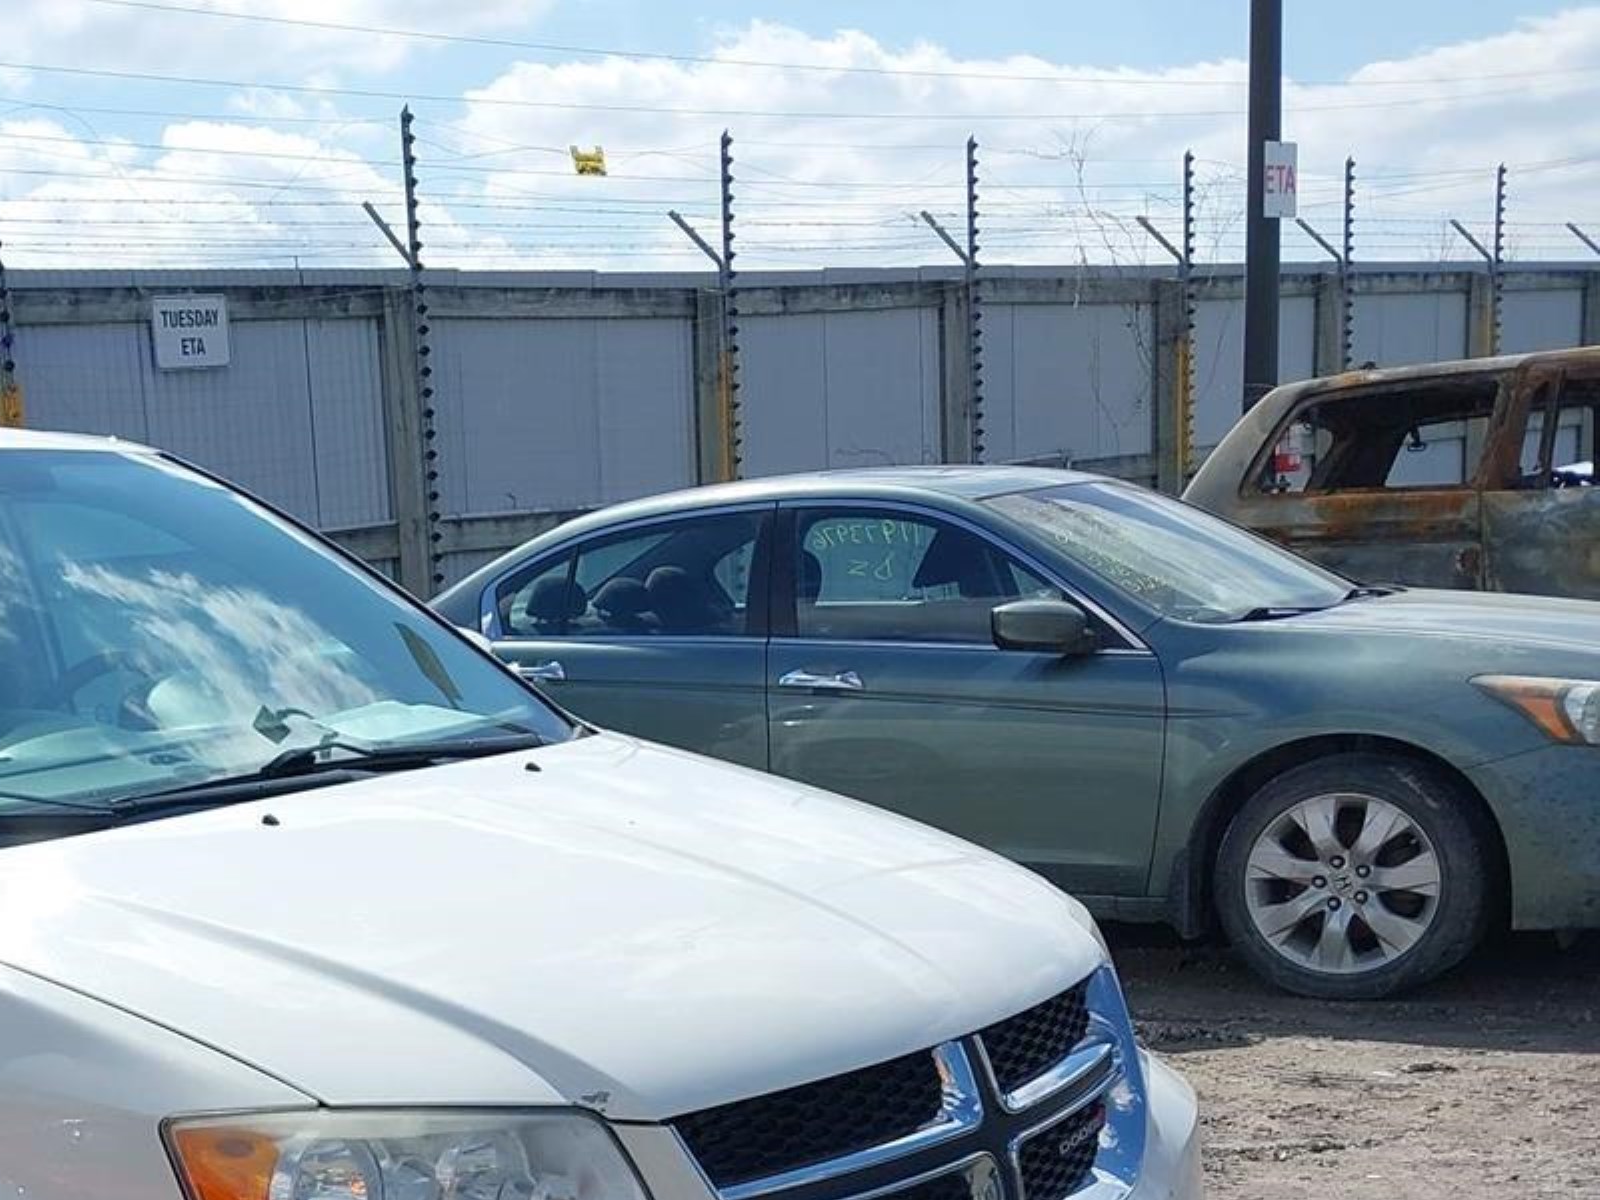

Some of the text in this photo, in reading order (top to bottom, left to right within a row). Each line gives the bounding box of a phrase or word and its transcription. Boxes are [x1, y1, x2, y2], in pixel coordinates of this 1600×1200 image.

[1264, 164, 1296, 194] ETA
[160, 308, 218, 328] TUESDAY
[181, 337, 206, 356] ETA
